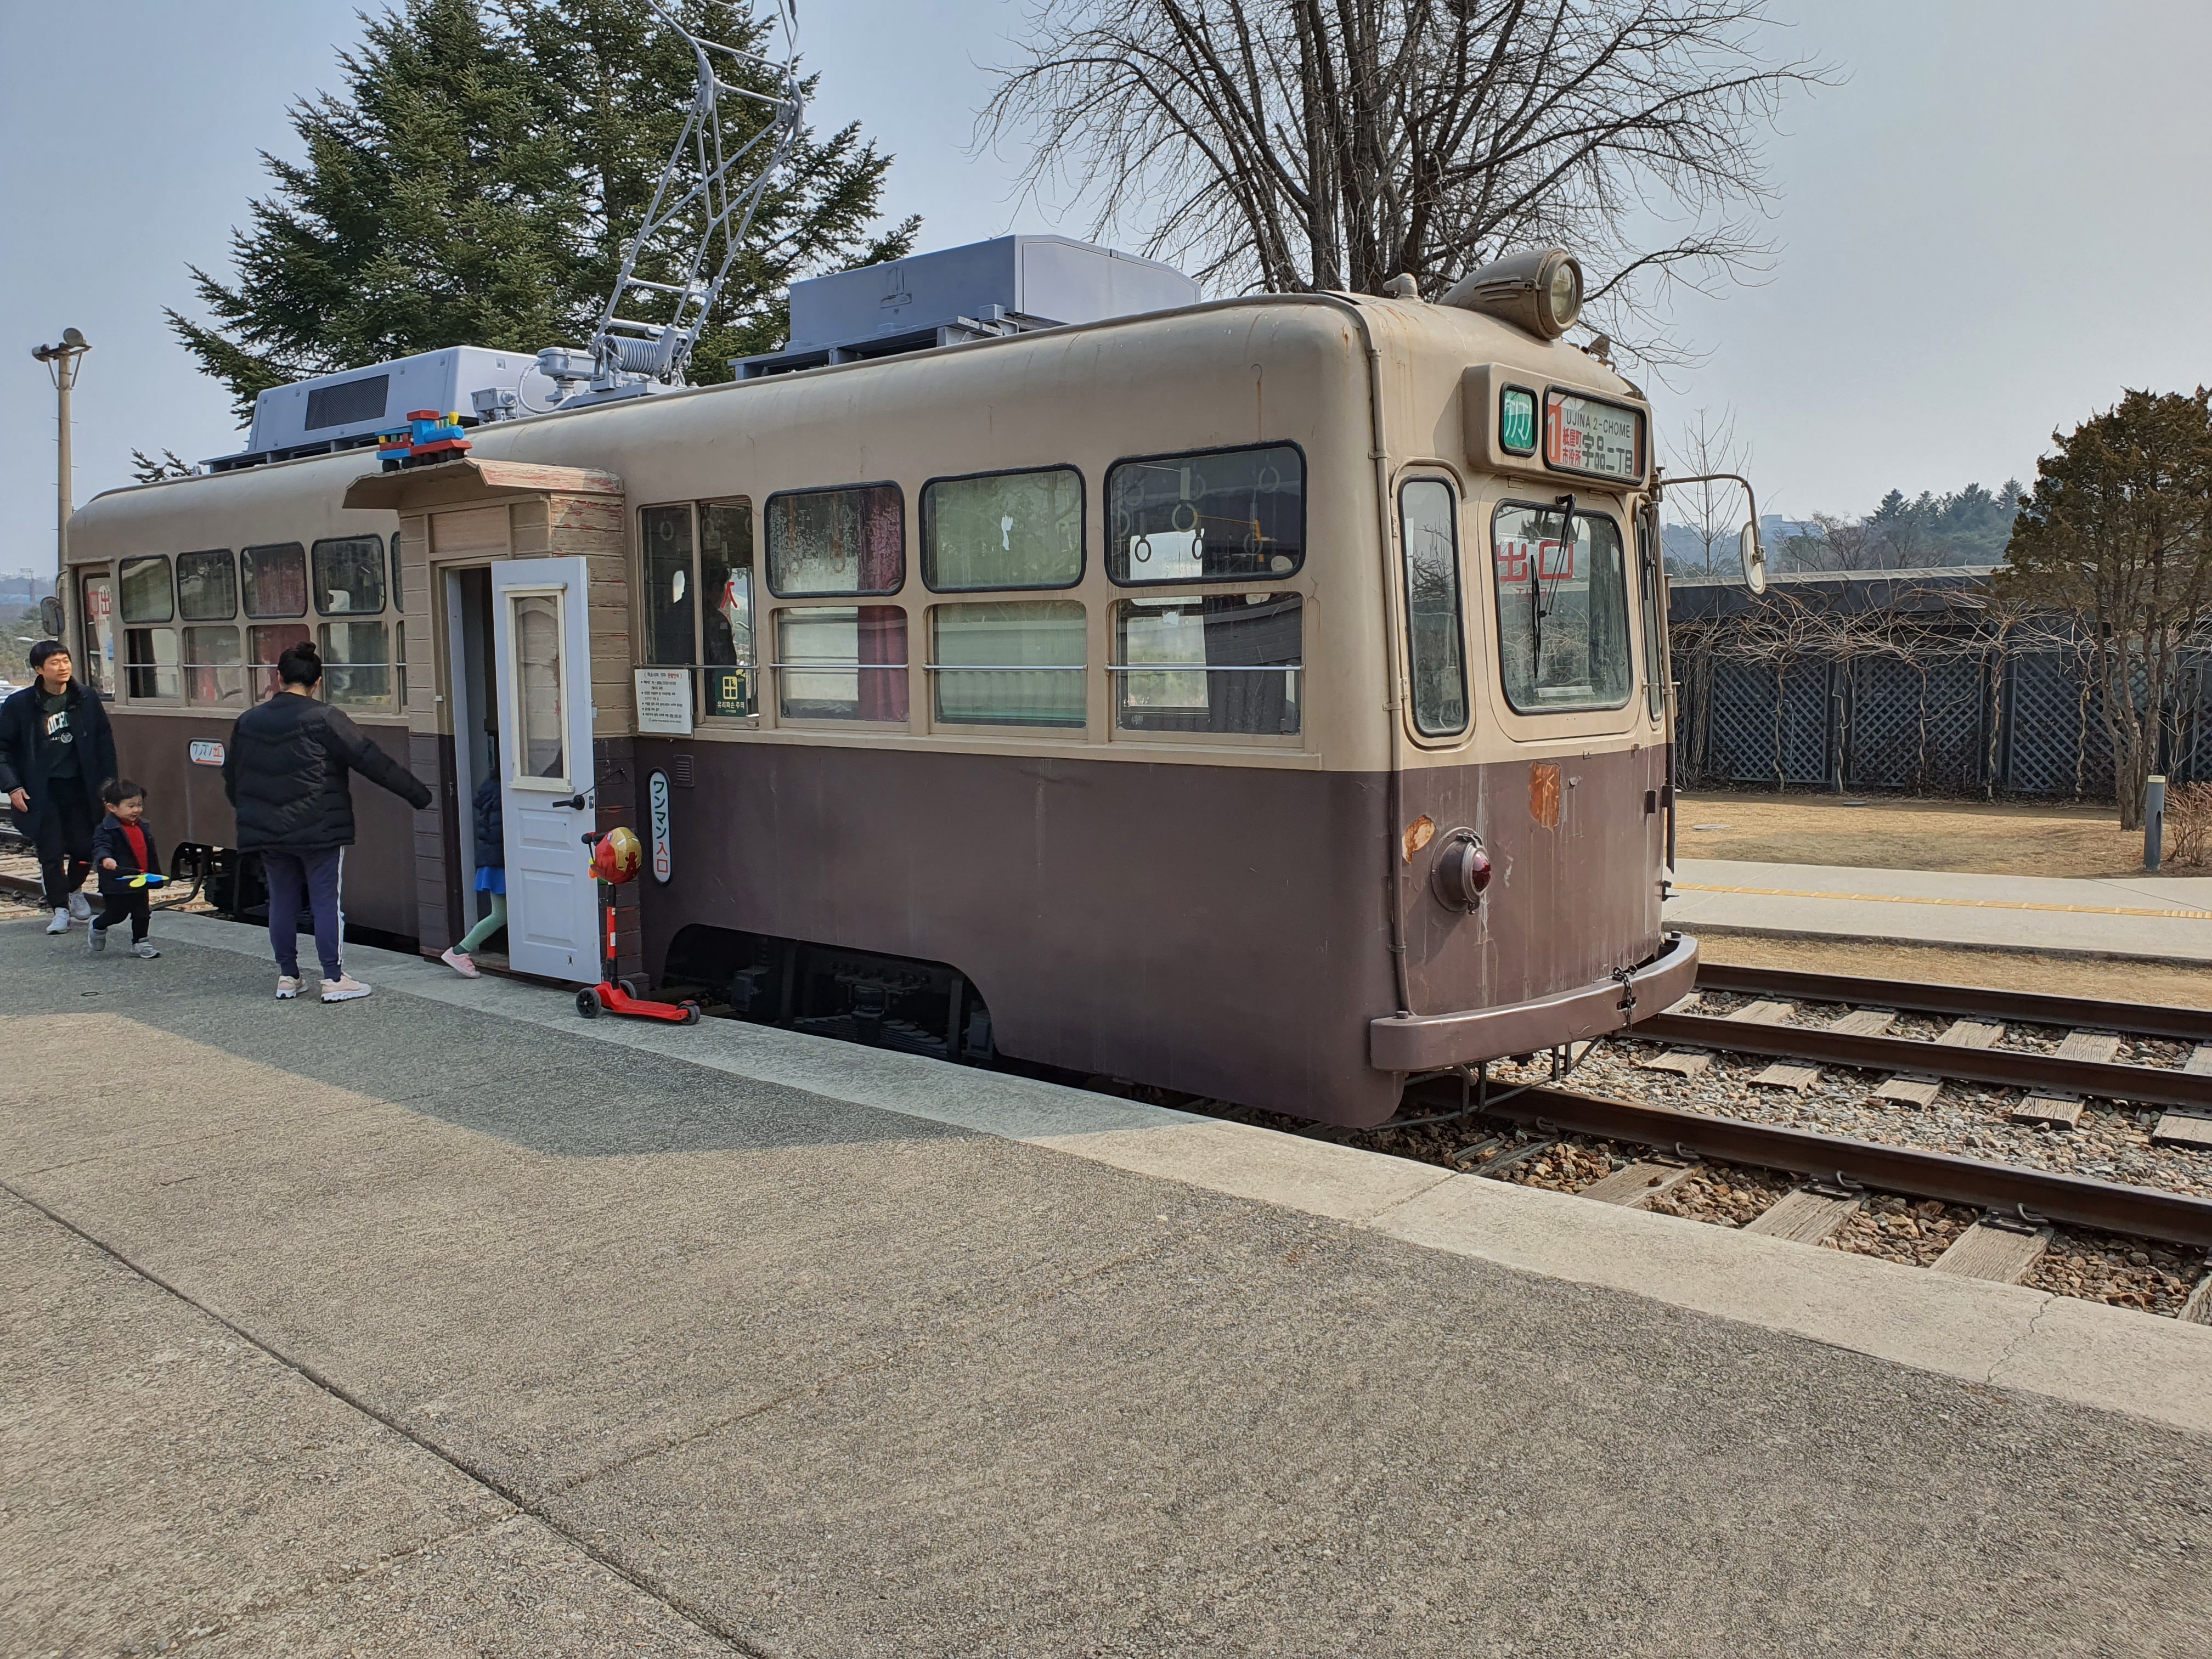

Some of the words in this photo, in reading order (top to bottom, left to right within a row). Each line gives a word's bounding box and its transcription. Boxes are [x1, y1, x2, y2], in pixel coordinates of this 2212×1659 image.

[1566, 410, 1590, 430] UJINA
[1593, 417, 1630, 438] 2-CHOME
[1562, 447, 1581, 467] 市役所
